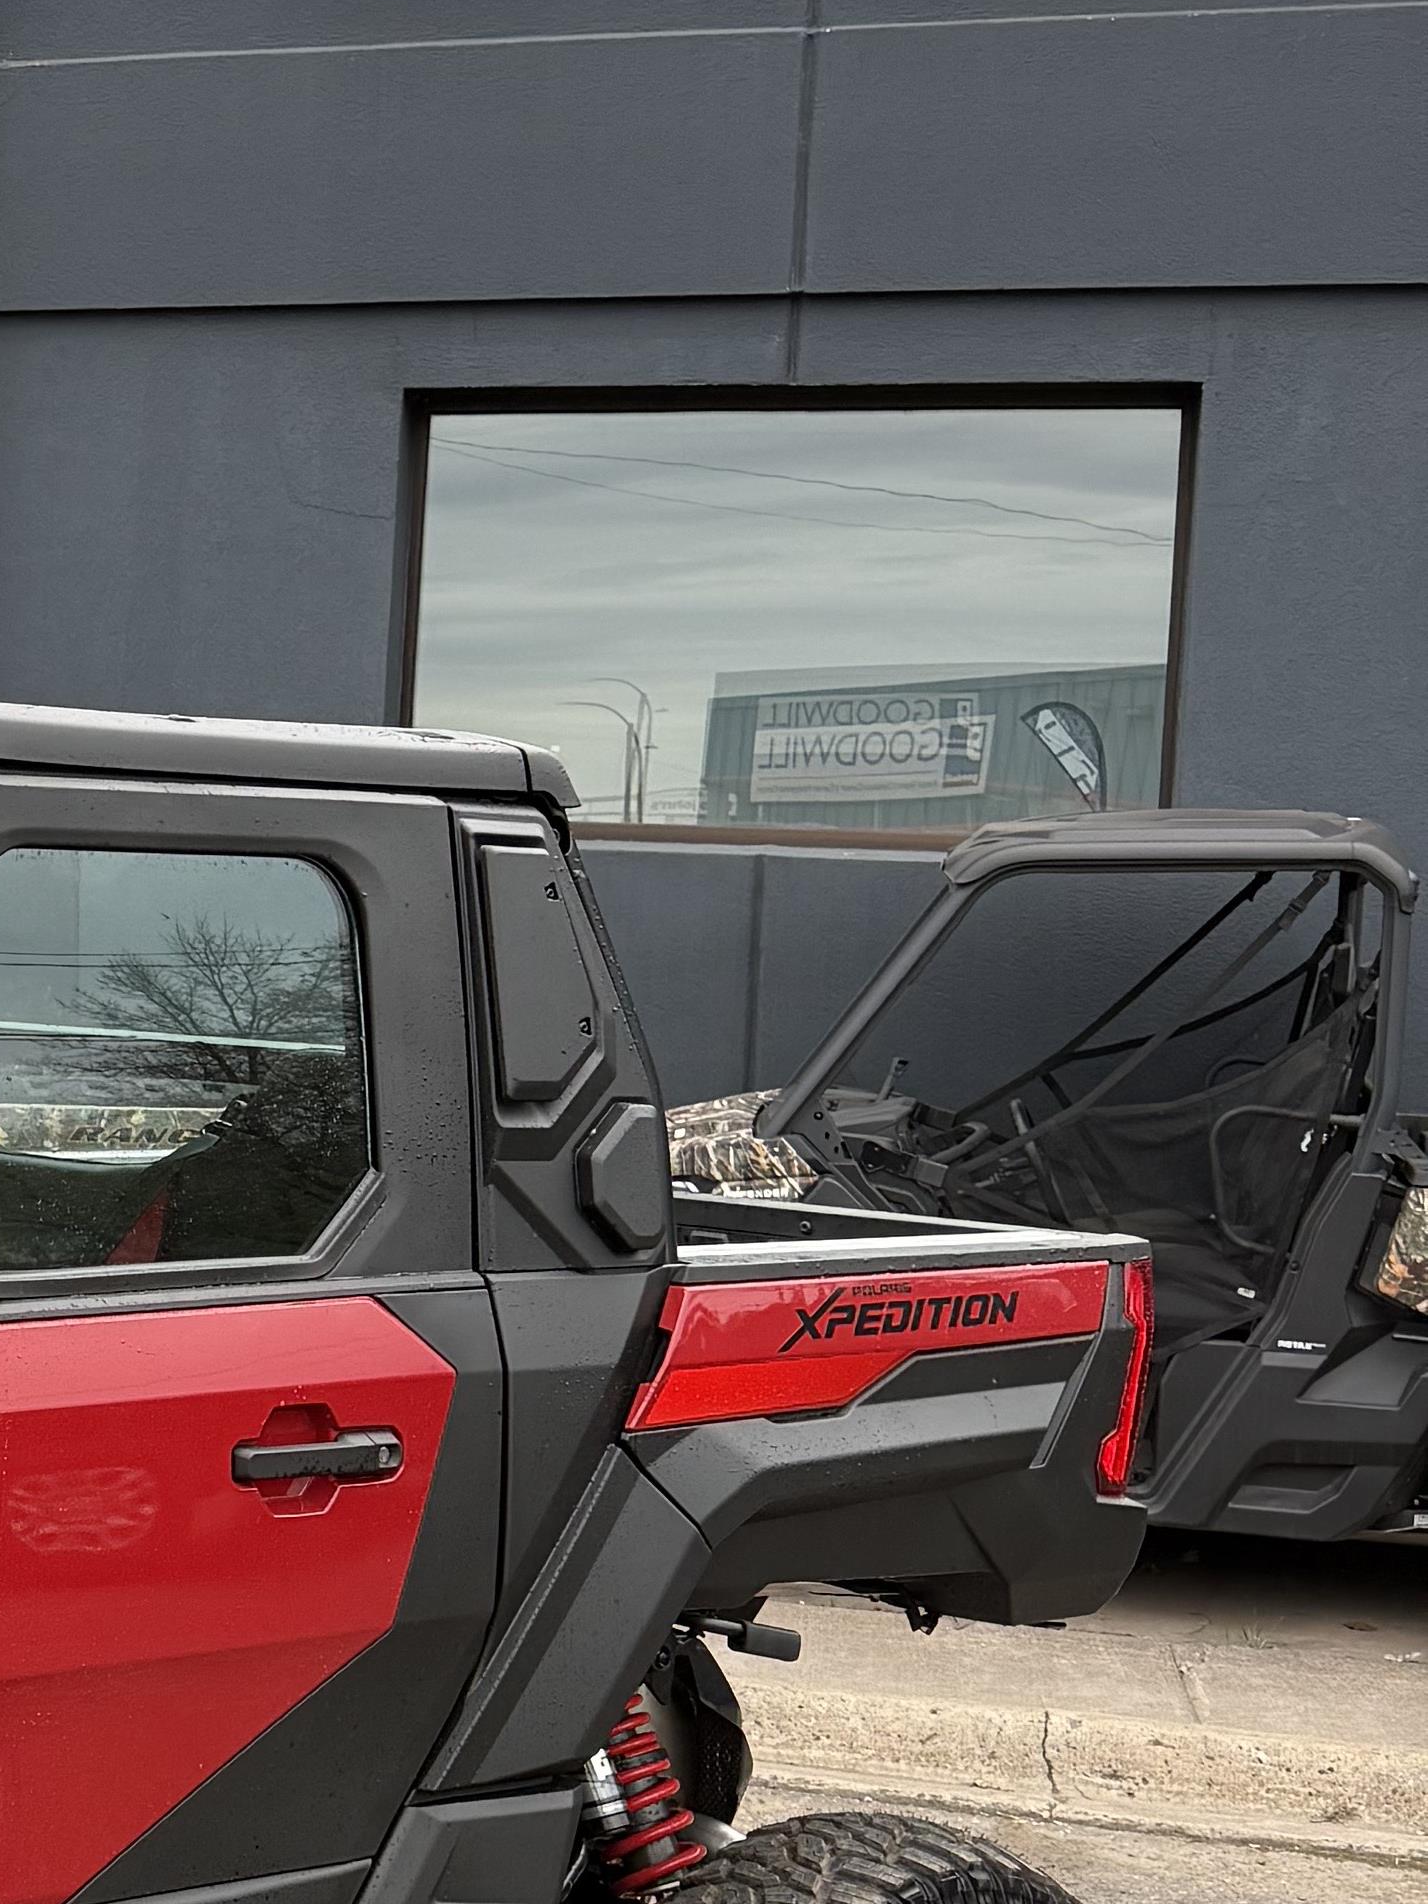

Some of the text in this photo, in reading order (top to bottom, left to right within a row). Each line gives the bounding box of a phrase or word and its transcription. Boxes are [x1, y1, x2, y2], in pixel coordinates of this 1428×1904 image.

[69, 1125, 203, 1144] RANG
[851, 1282, 912, 1296] POLARIS
[778, 1287, 1019, 1353] XPEDITION
